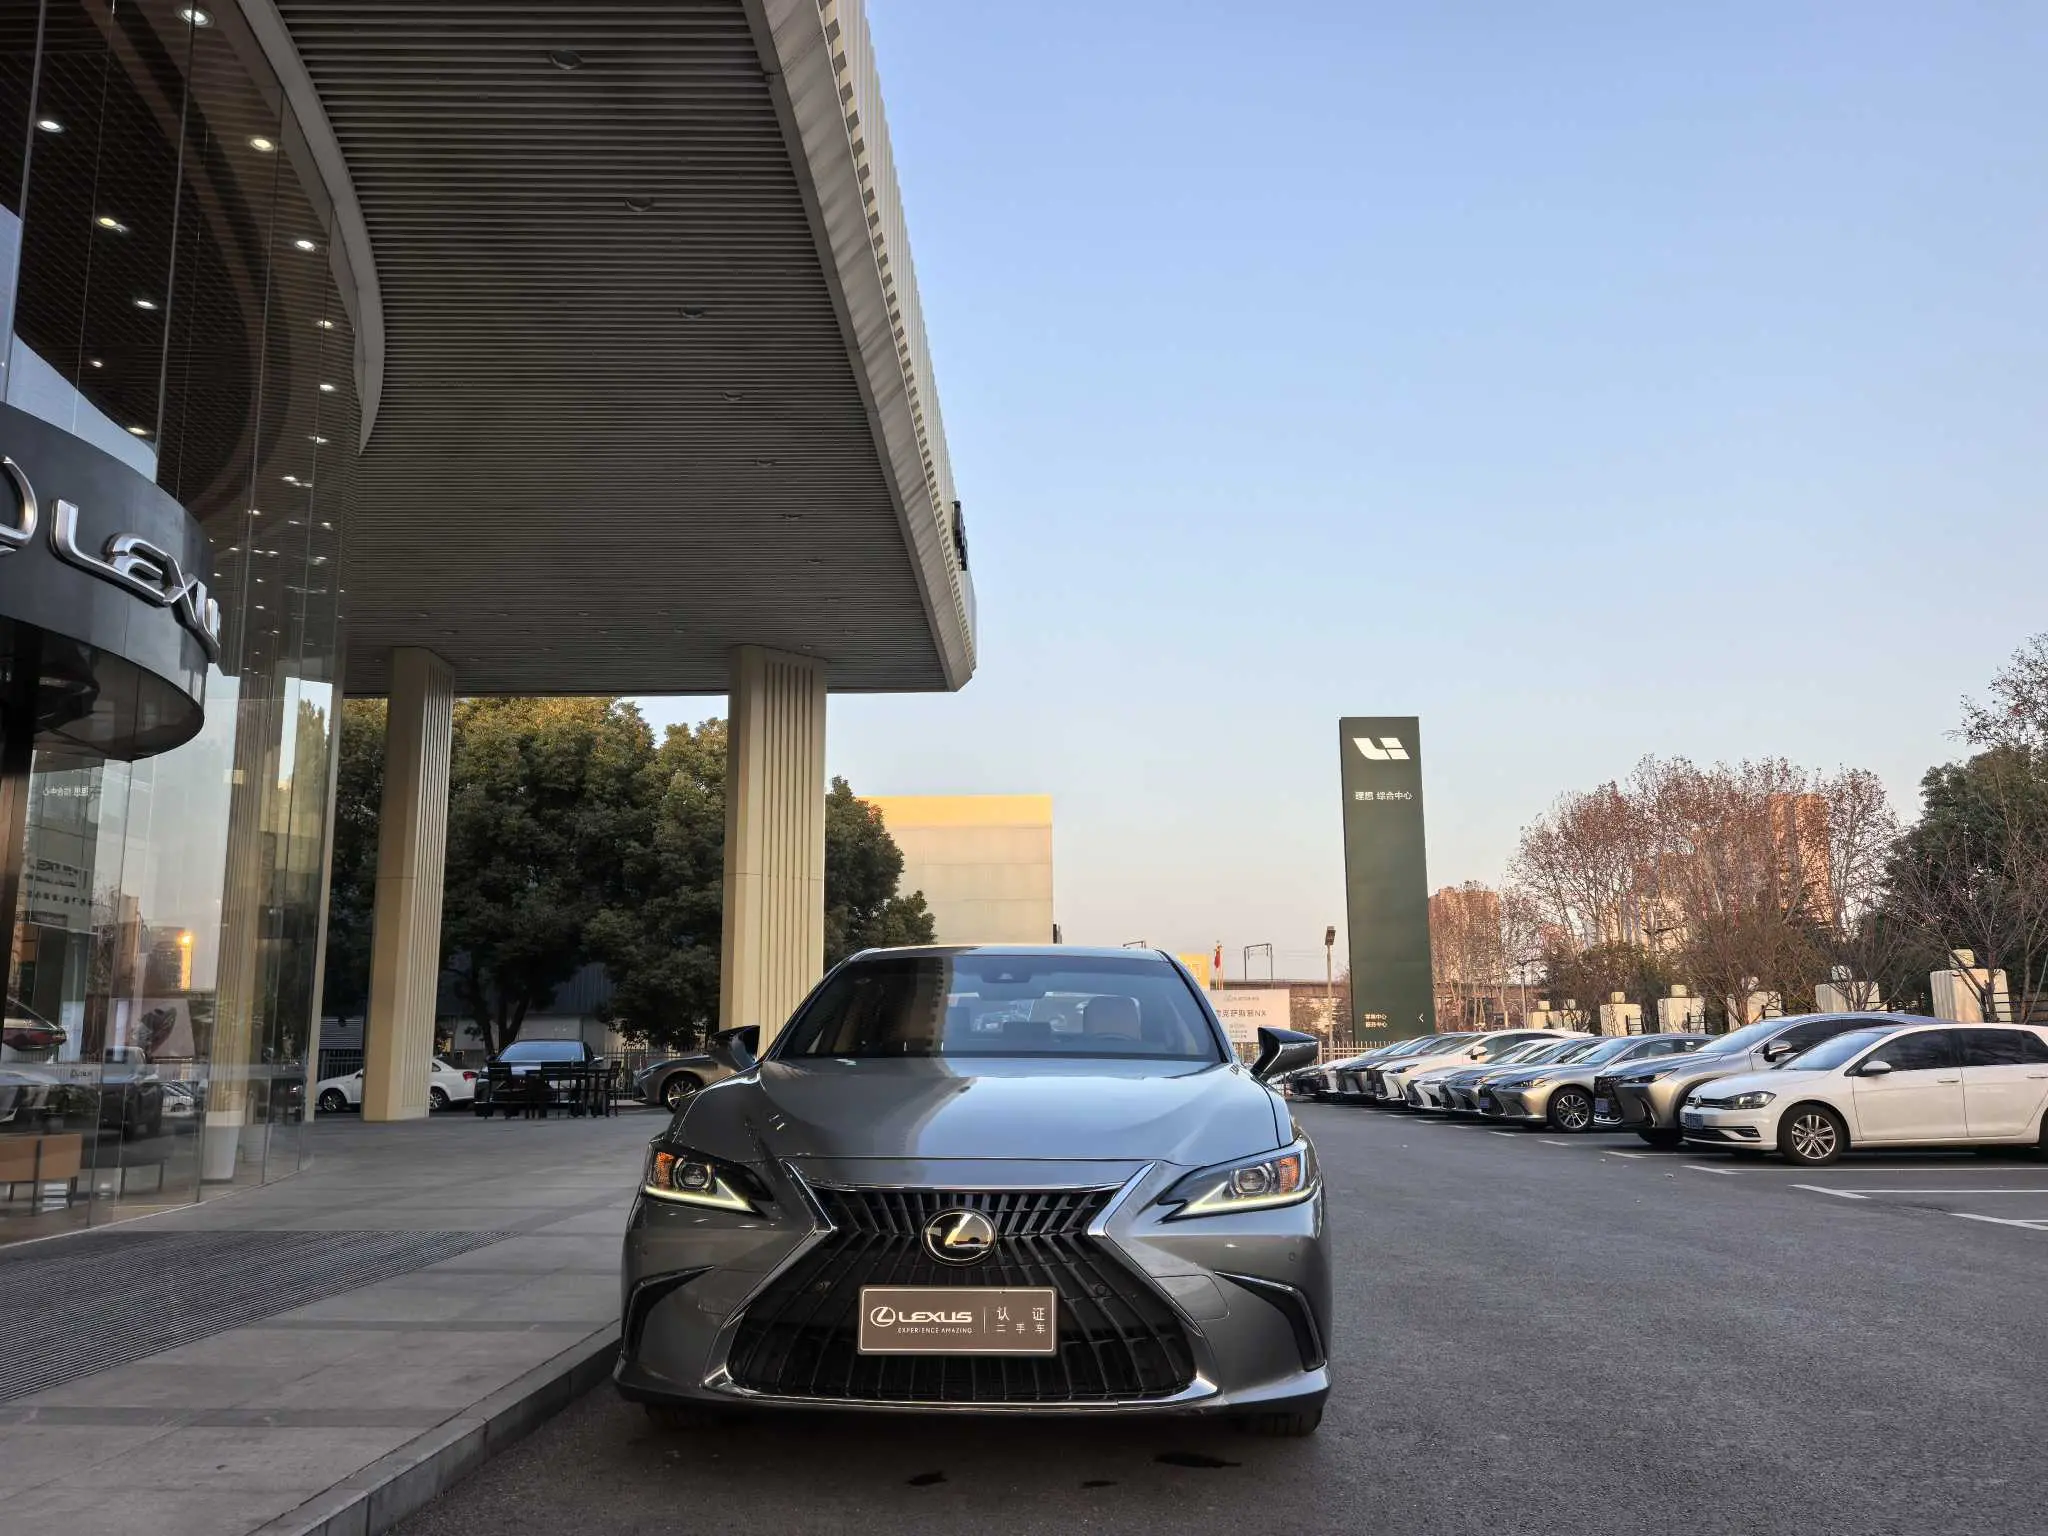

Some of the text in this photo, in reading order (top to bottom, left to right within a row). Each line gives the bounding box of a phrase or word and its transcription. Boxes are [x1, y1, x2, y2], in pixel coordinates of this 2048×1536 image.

[49, 498, 221, 663] LEXU
[1355, 790, 1412, 801] 理想 综合中心
[898, 1311, 973, 1323] LEXUS
[996, 1306, 1046, 1321] 认证
[897, 1327, 973, 1335] EXPERIENCE AMAZING
[995, 1323, 1046, 1334] 二手车
